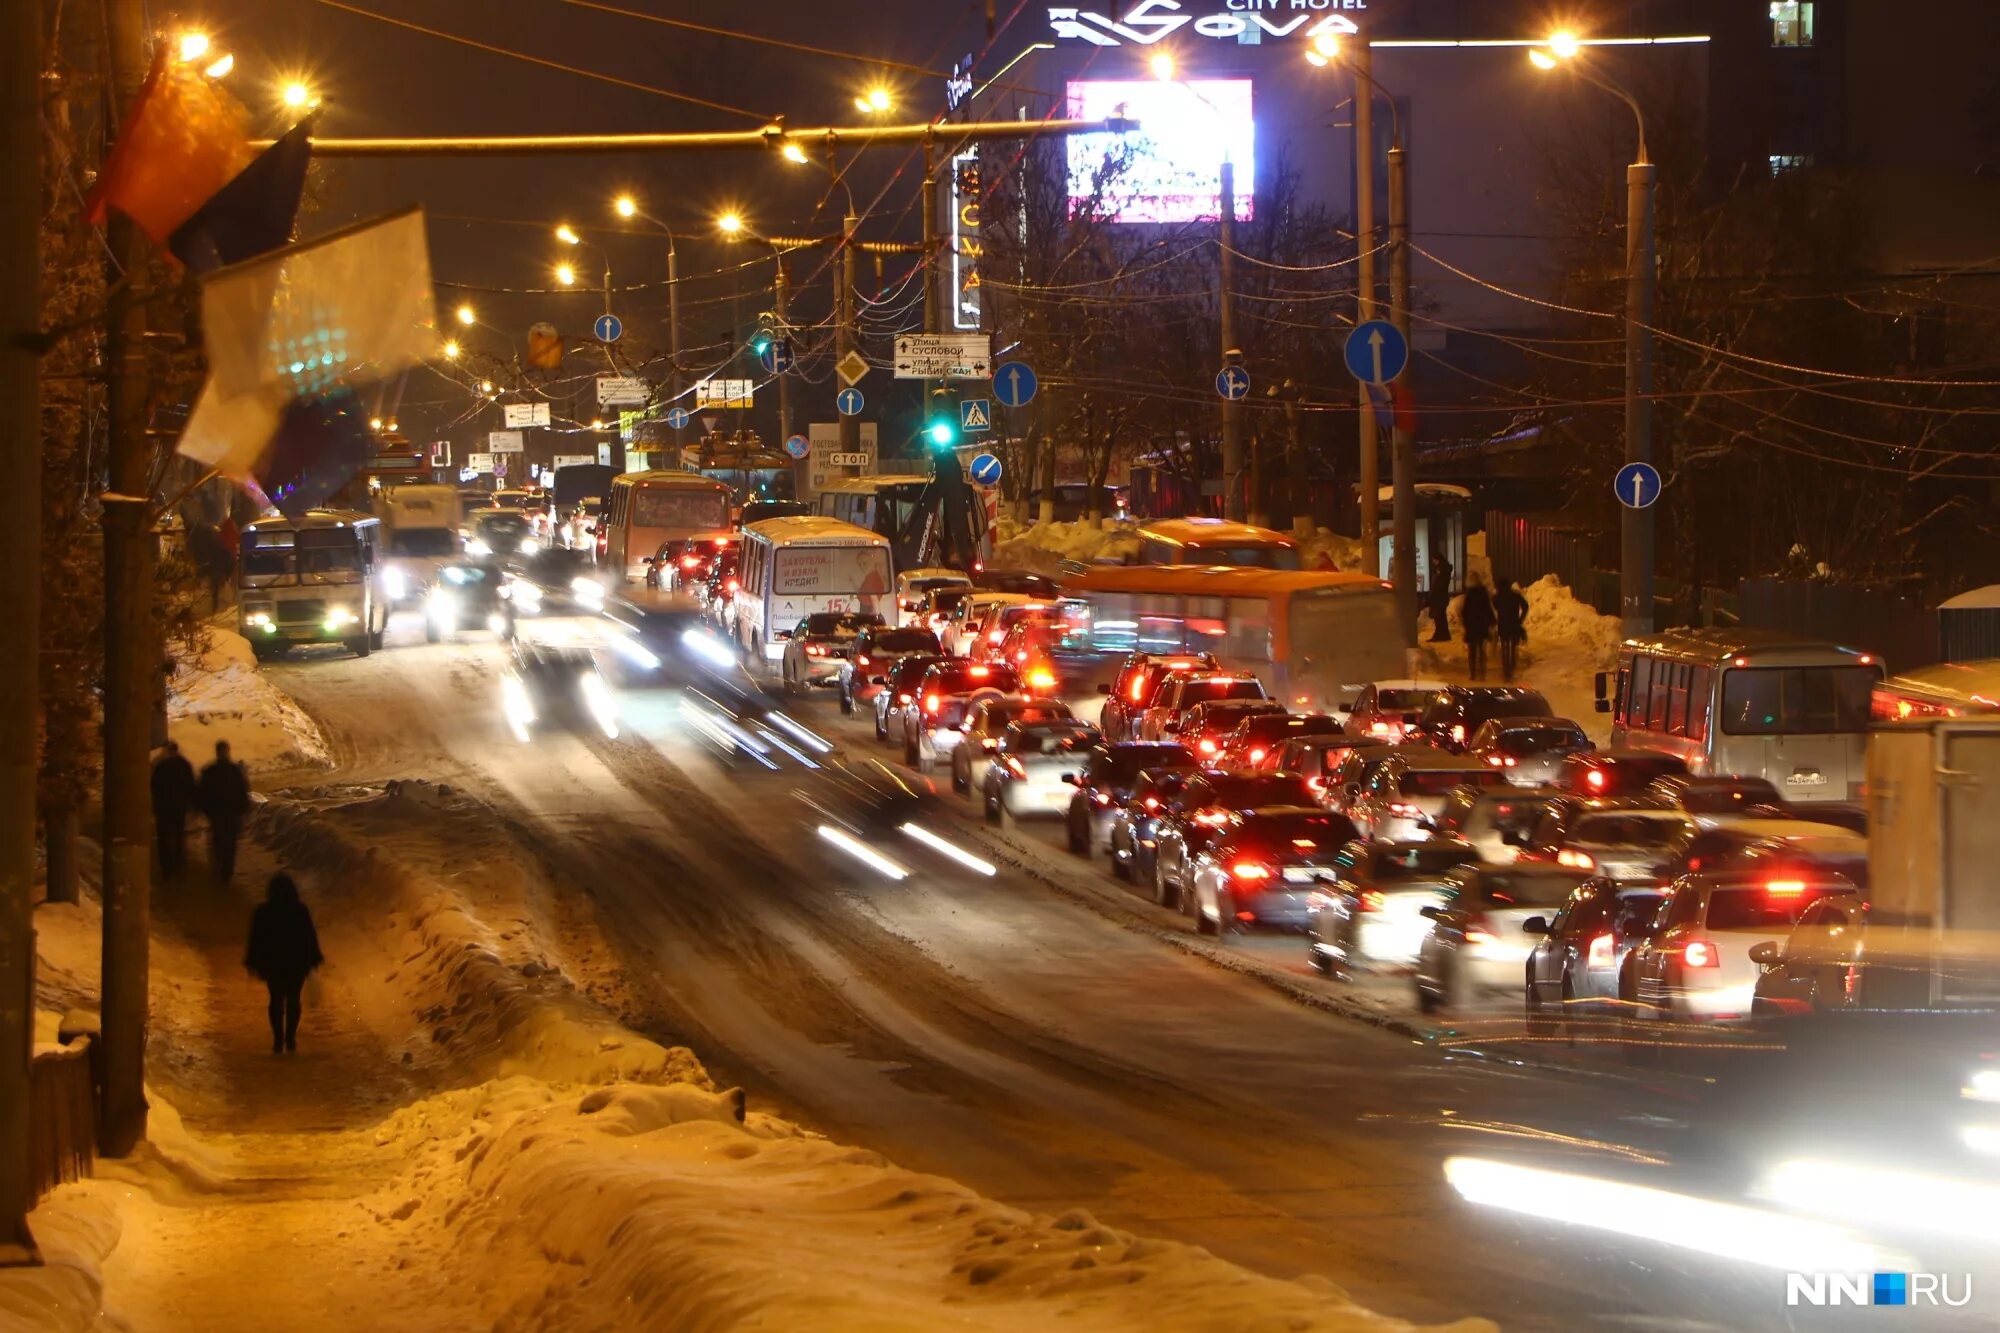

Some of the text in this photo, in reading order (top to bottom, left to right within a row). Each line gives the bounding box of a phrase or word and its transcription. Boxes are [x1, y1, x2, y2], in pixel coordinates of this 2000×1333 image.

[912, 338, 940, 346] улица
[912, 346, 964, 355] СУСЛОВОЙ
[832, 454, 867, 464] СТОП
